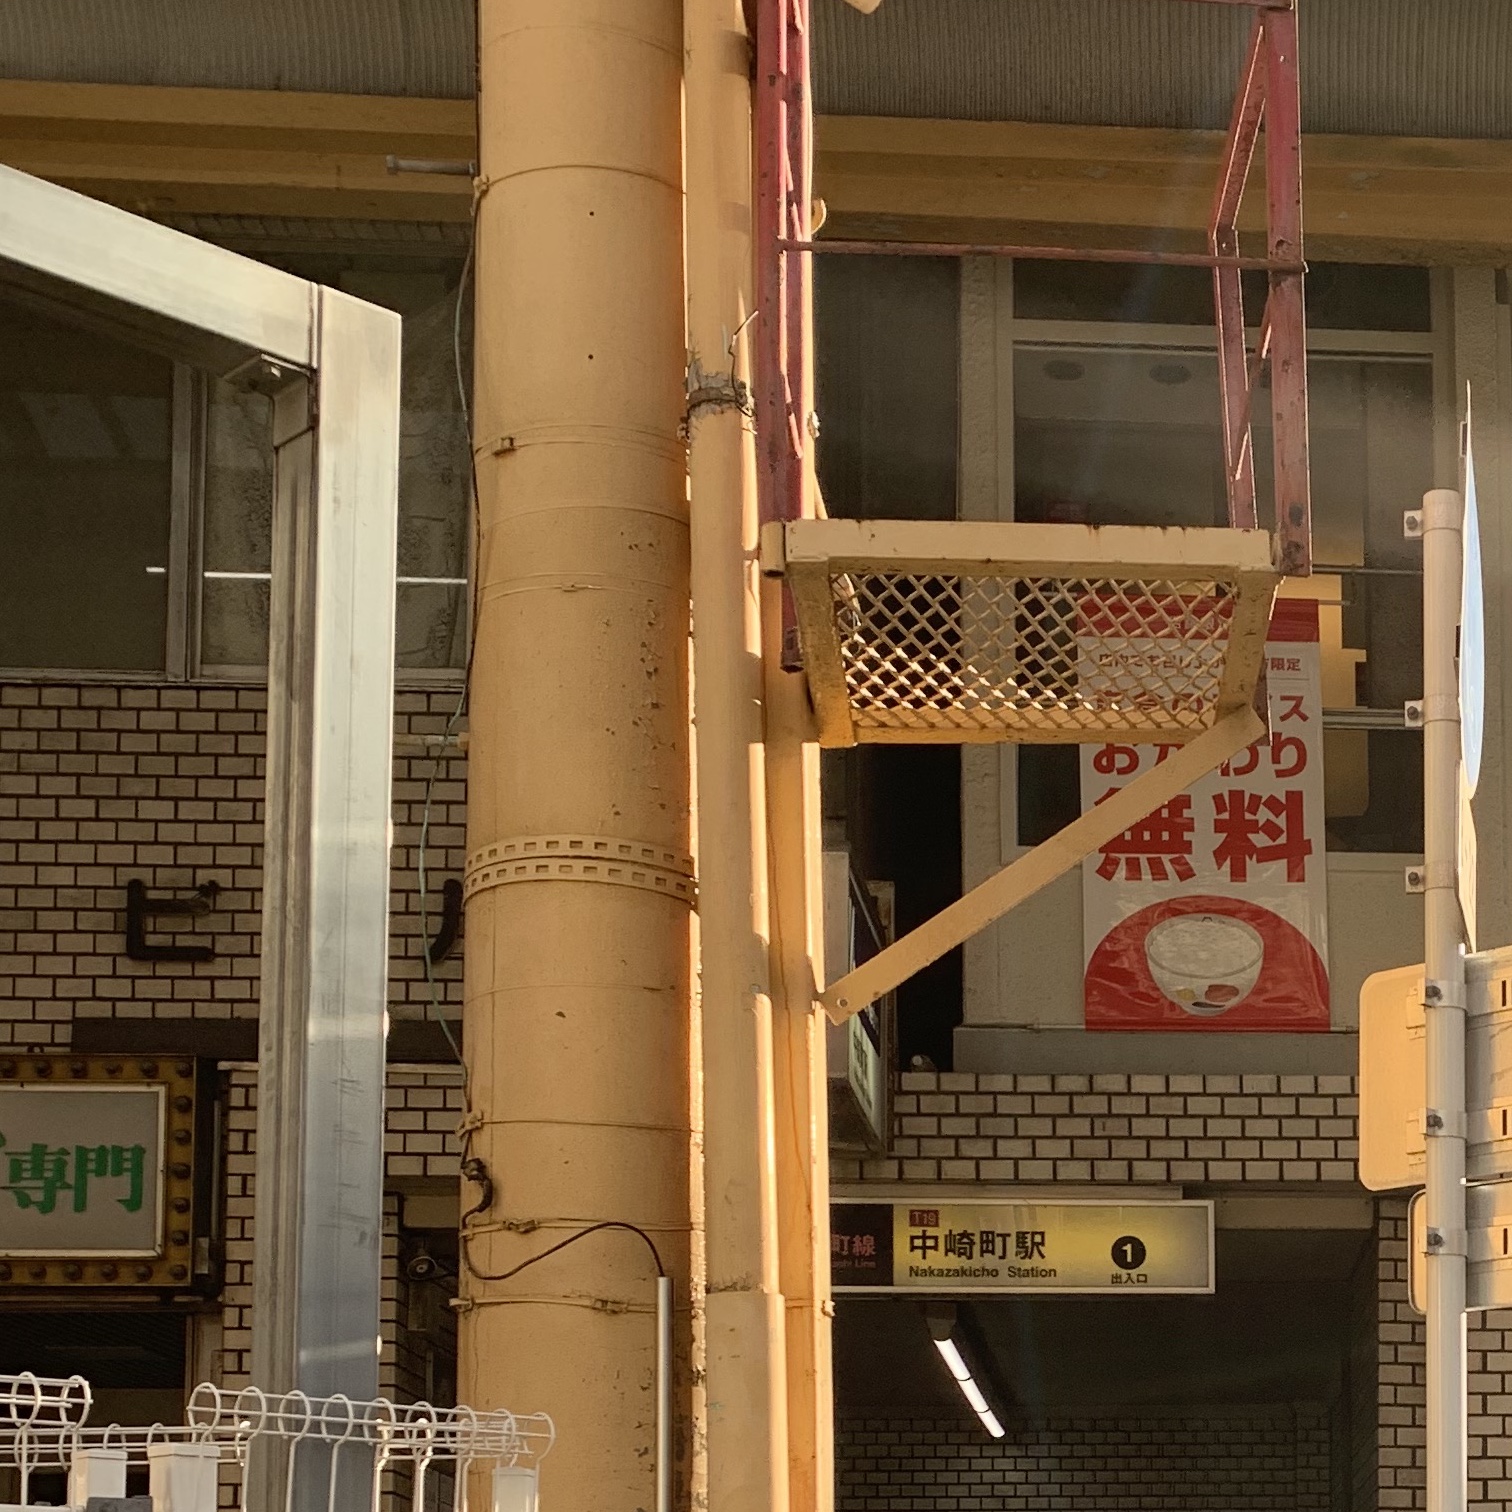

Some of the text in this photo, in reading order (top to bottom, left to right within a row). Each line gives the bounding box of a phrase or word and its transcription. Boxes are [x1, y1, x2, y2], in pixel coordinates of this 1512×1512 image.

[0, 1131, 146, 1214] 専門
[908, 1229, 1047, 1261] 中崎町駅
[908, 1265, 1057, 1279] Nakazakicho Station
[1110, 1272, 1149, 1285] 出入口
